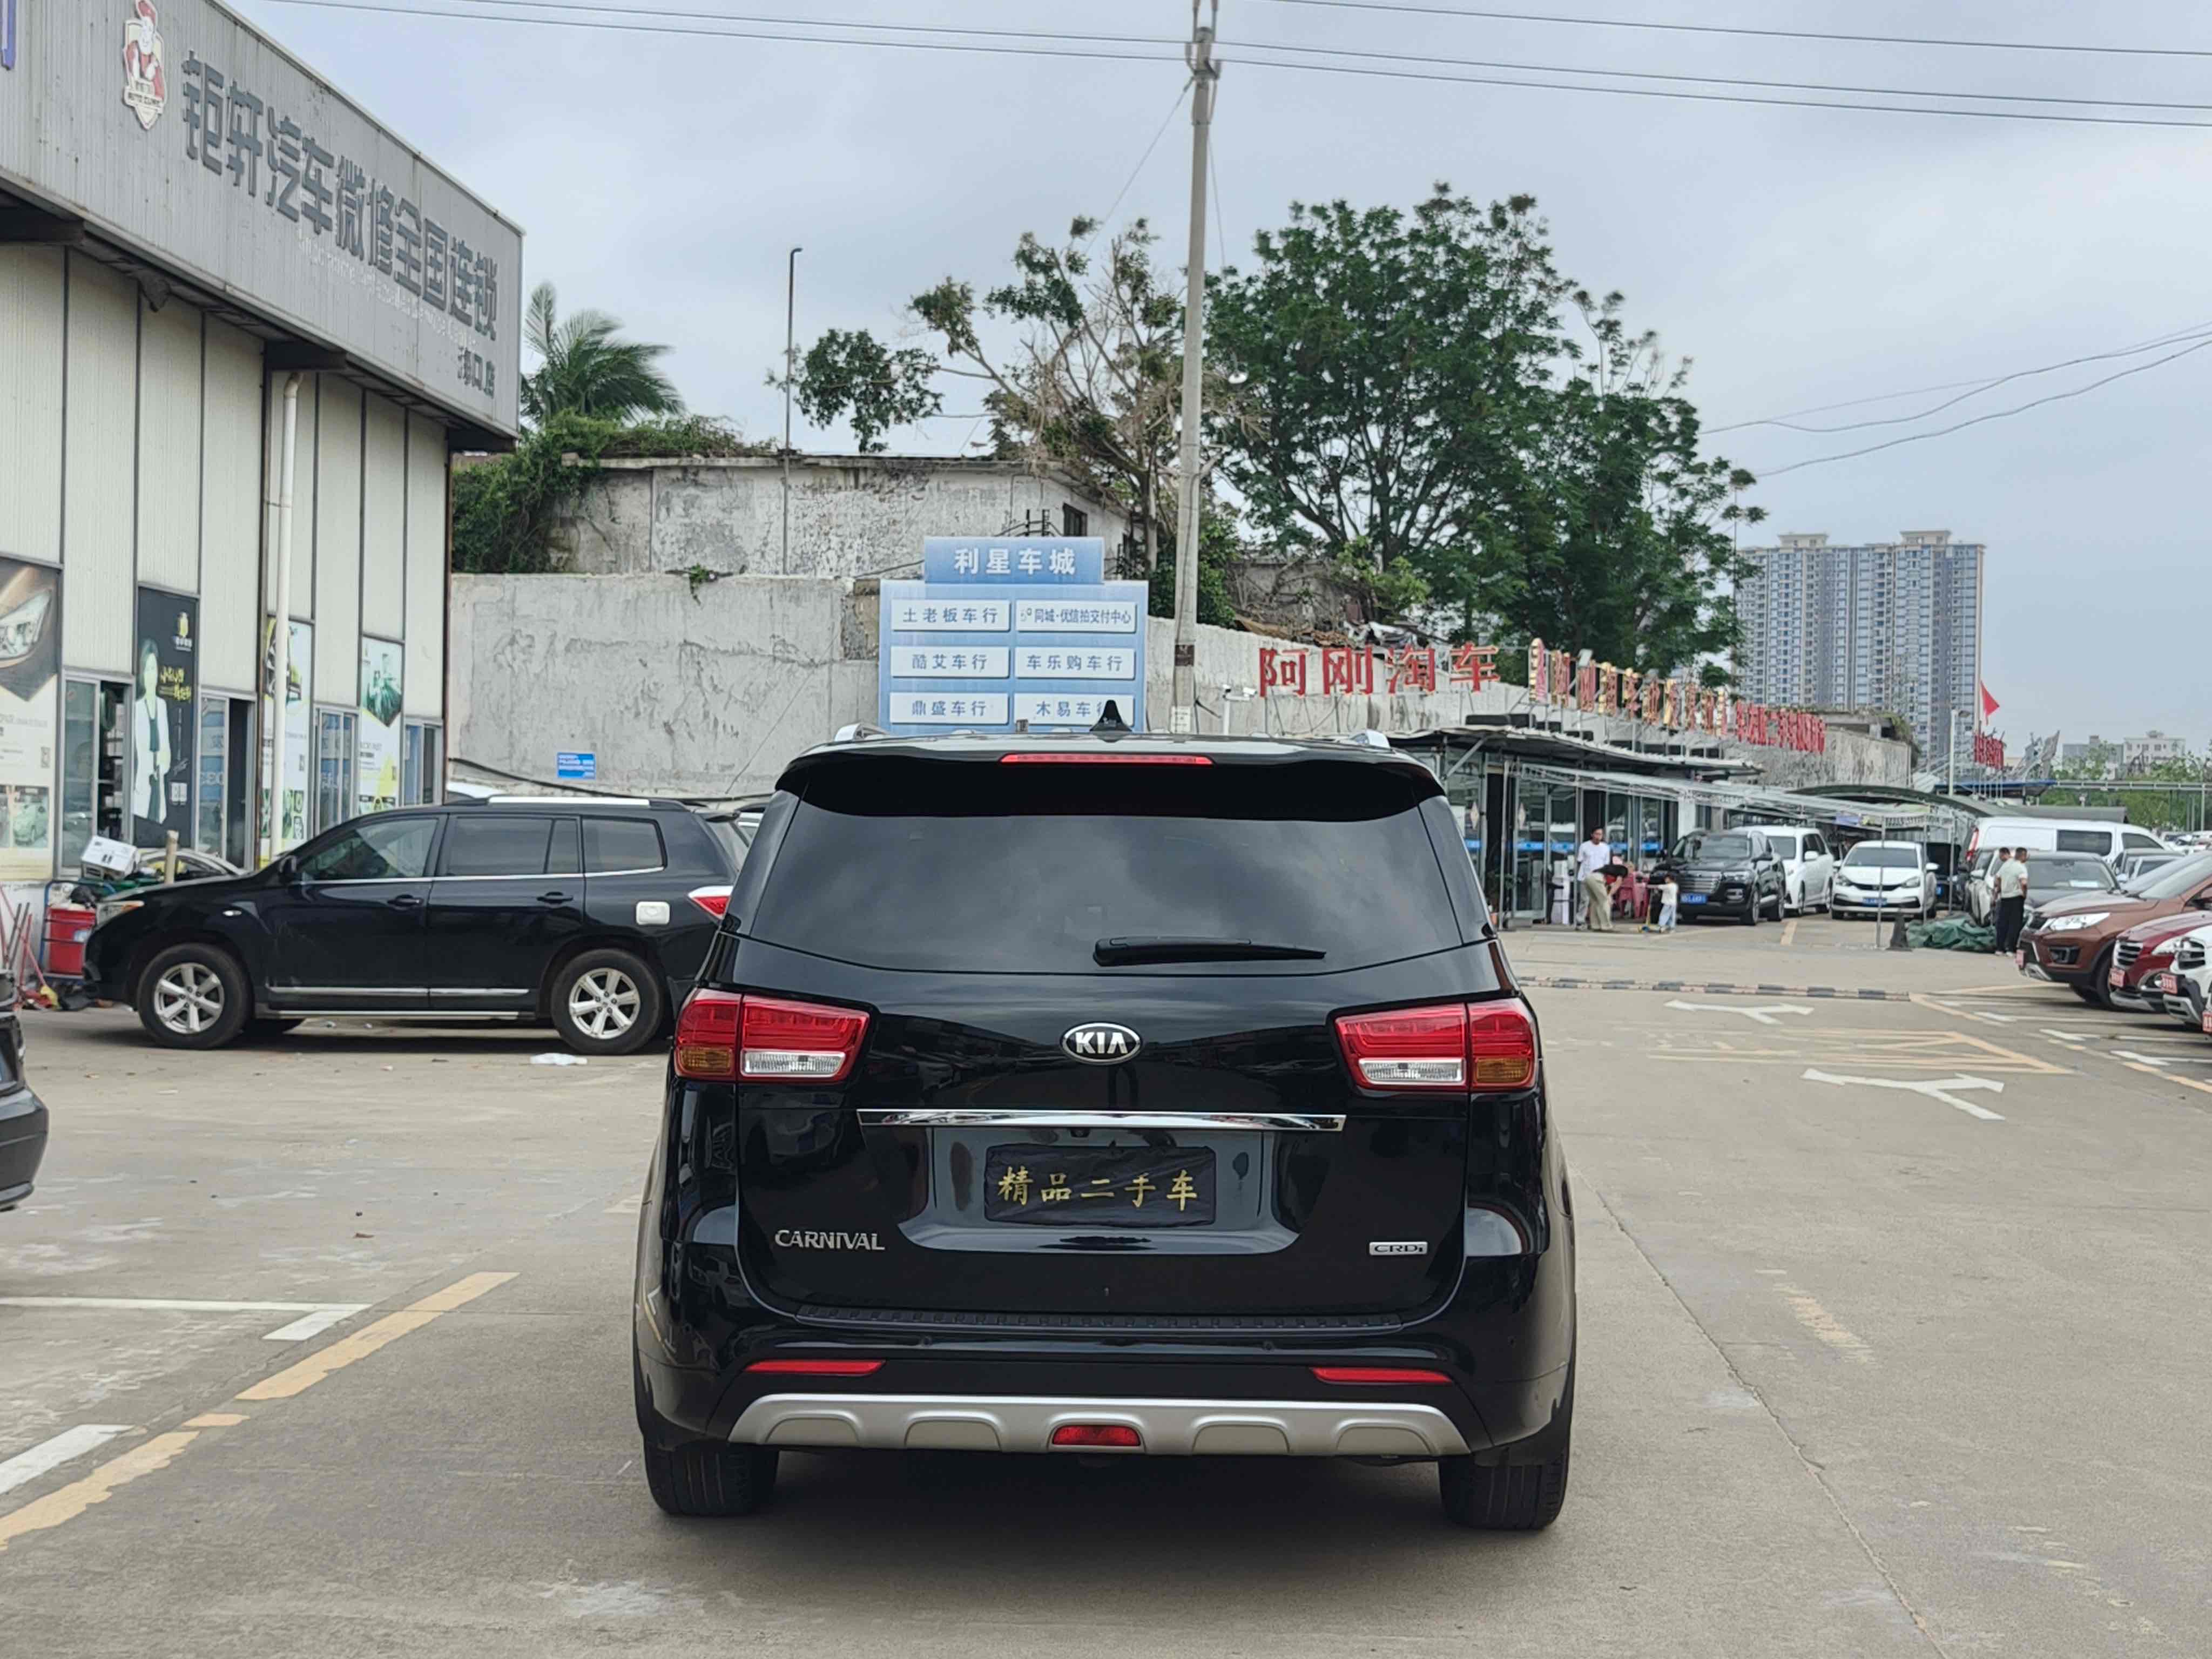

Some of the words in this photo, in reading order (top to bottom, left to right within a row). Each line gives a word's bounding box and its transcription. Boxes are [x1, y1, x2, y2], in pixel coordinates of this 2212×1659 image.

[954, 548, 1077, 575] 利星车城
[903, 608, 999, 624] 土老板车行
[912, 654, 988, 672] 酷艾车行
[1026, 655, 1123, 672] 车乐购车行
[1259, 643, 1500, 698] 阿刚淘车
[911, 700, 988, 718] 鼎盛车行
[1075, 1032, 1128, 1054] KIA
[997, 1165, 1197, 1211] 精品二手车
[775, 1230, 885, 1250] CARNIVAL
